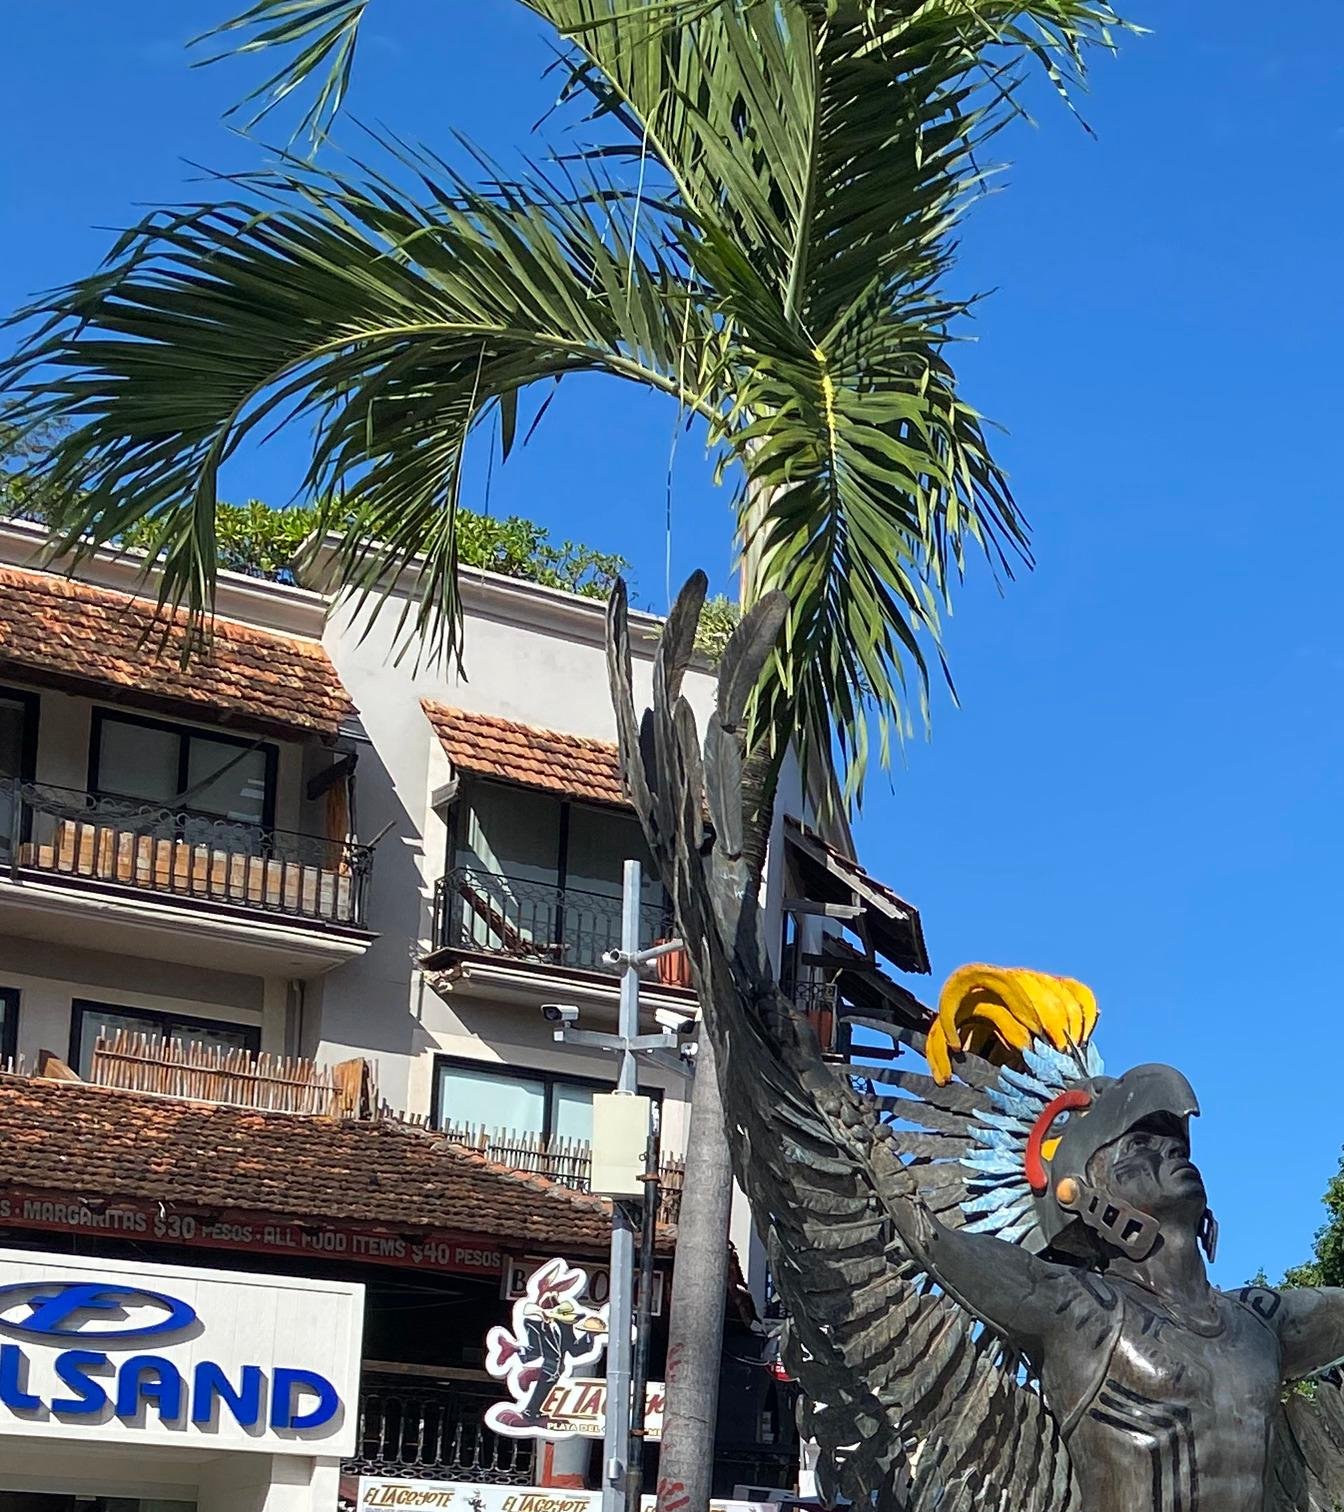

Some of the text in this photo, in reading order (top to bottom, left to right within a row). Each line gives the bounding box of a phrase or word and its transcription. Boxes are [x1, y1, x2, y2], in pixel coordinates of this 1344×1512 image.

[154, 1213, 195, 1239] $30
[264, 1226, 296, 1247] ALL
[353, 1235, 405, 1257] ITEMS
[412, 1242, 449, 1263] $40
[455, 1248, 500, 1267] PESOS
[547, 1423, 578, 1432] PLAYA
[381, 1485, 455, 1508] TACOYOTE
